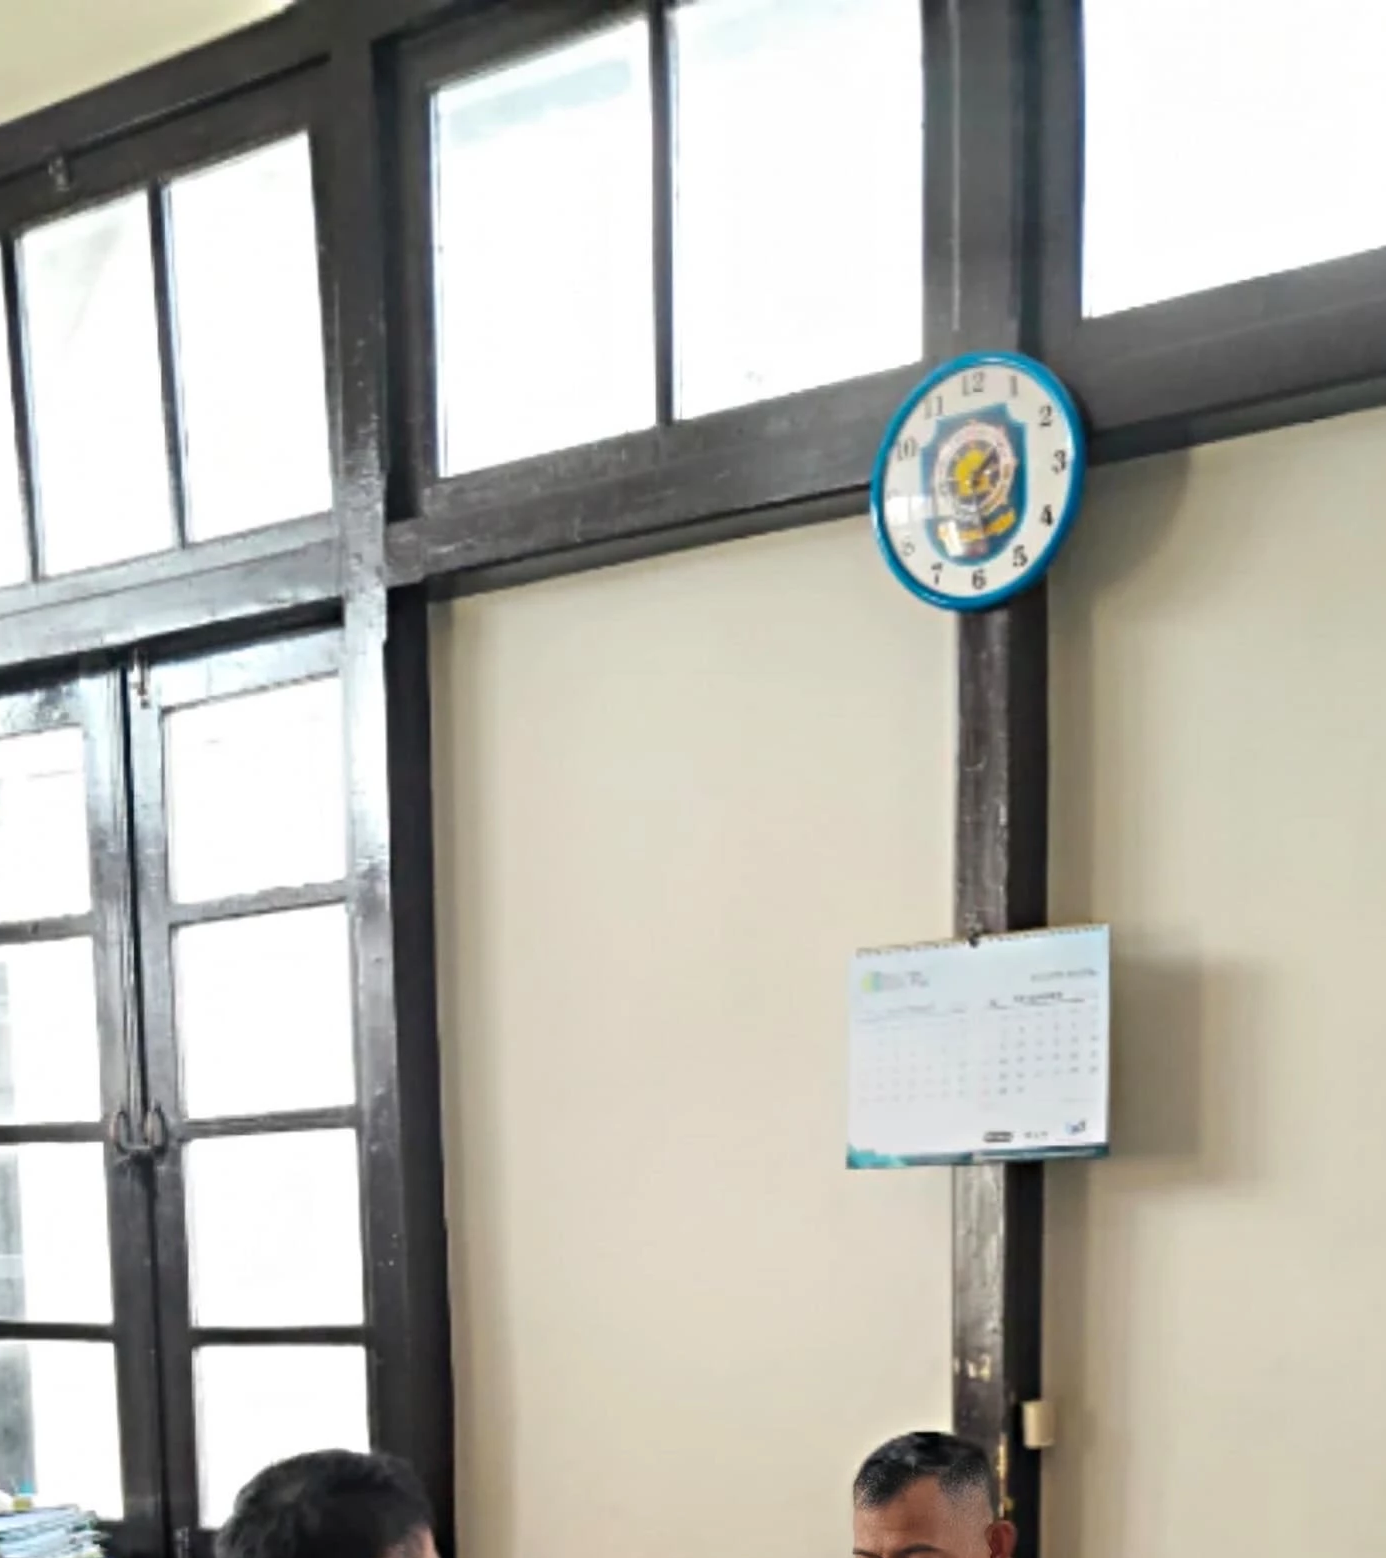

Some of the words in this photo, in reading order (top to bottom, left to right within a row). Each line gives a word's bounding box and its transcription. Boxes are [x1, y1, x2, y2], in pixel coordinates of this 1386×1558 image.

[961, 371, 986, 397] 12
[1009, 375, 1019, 397] 1
[924, 395, 943, 419] 11
[1038, 405, 1053, 428] 2
[897, 436, 917, 461] 10
[1050, 449, 1067, 474] 3
[1039, 504, 1053, 527] 4
[1012, 545, 1029, 568] 5
[930, 561, 943, 585] 7
[971, 569, 987, 590] 6
